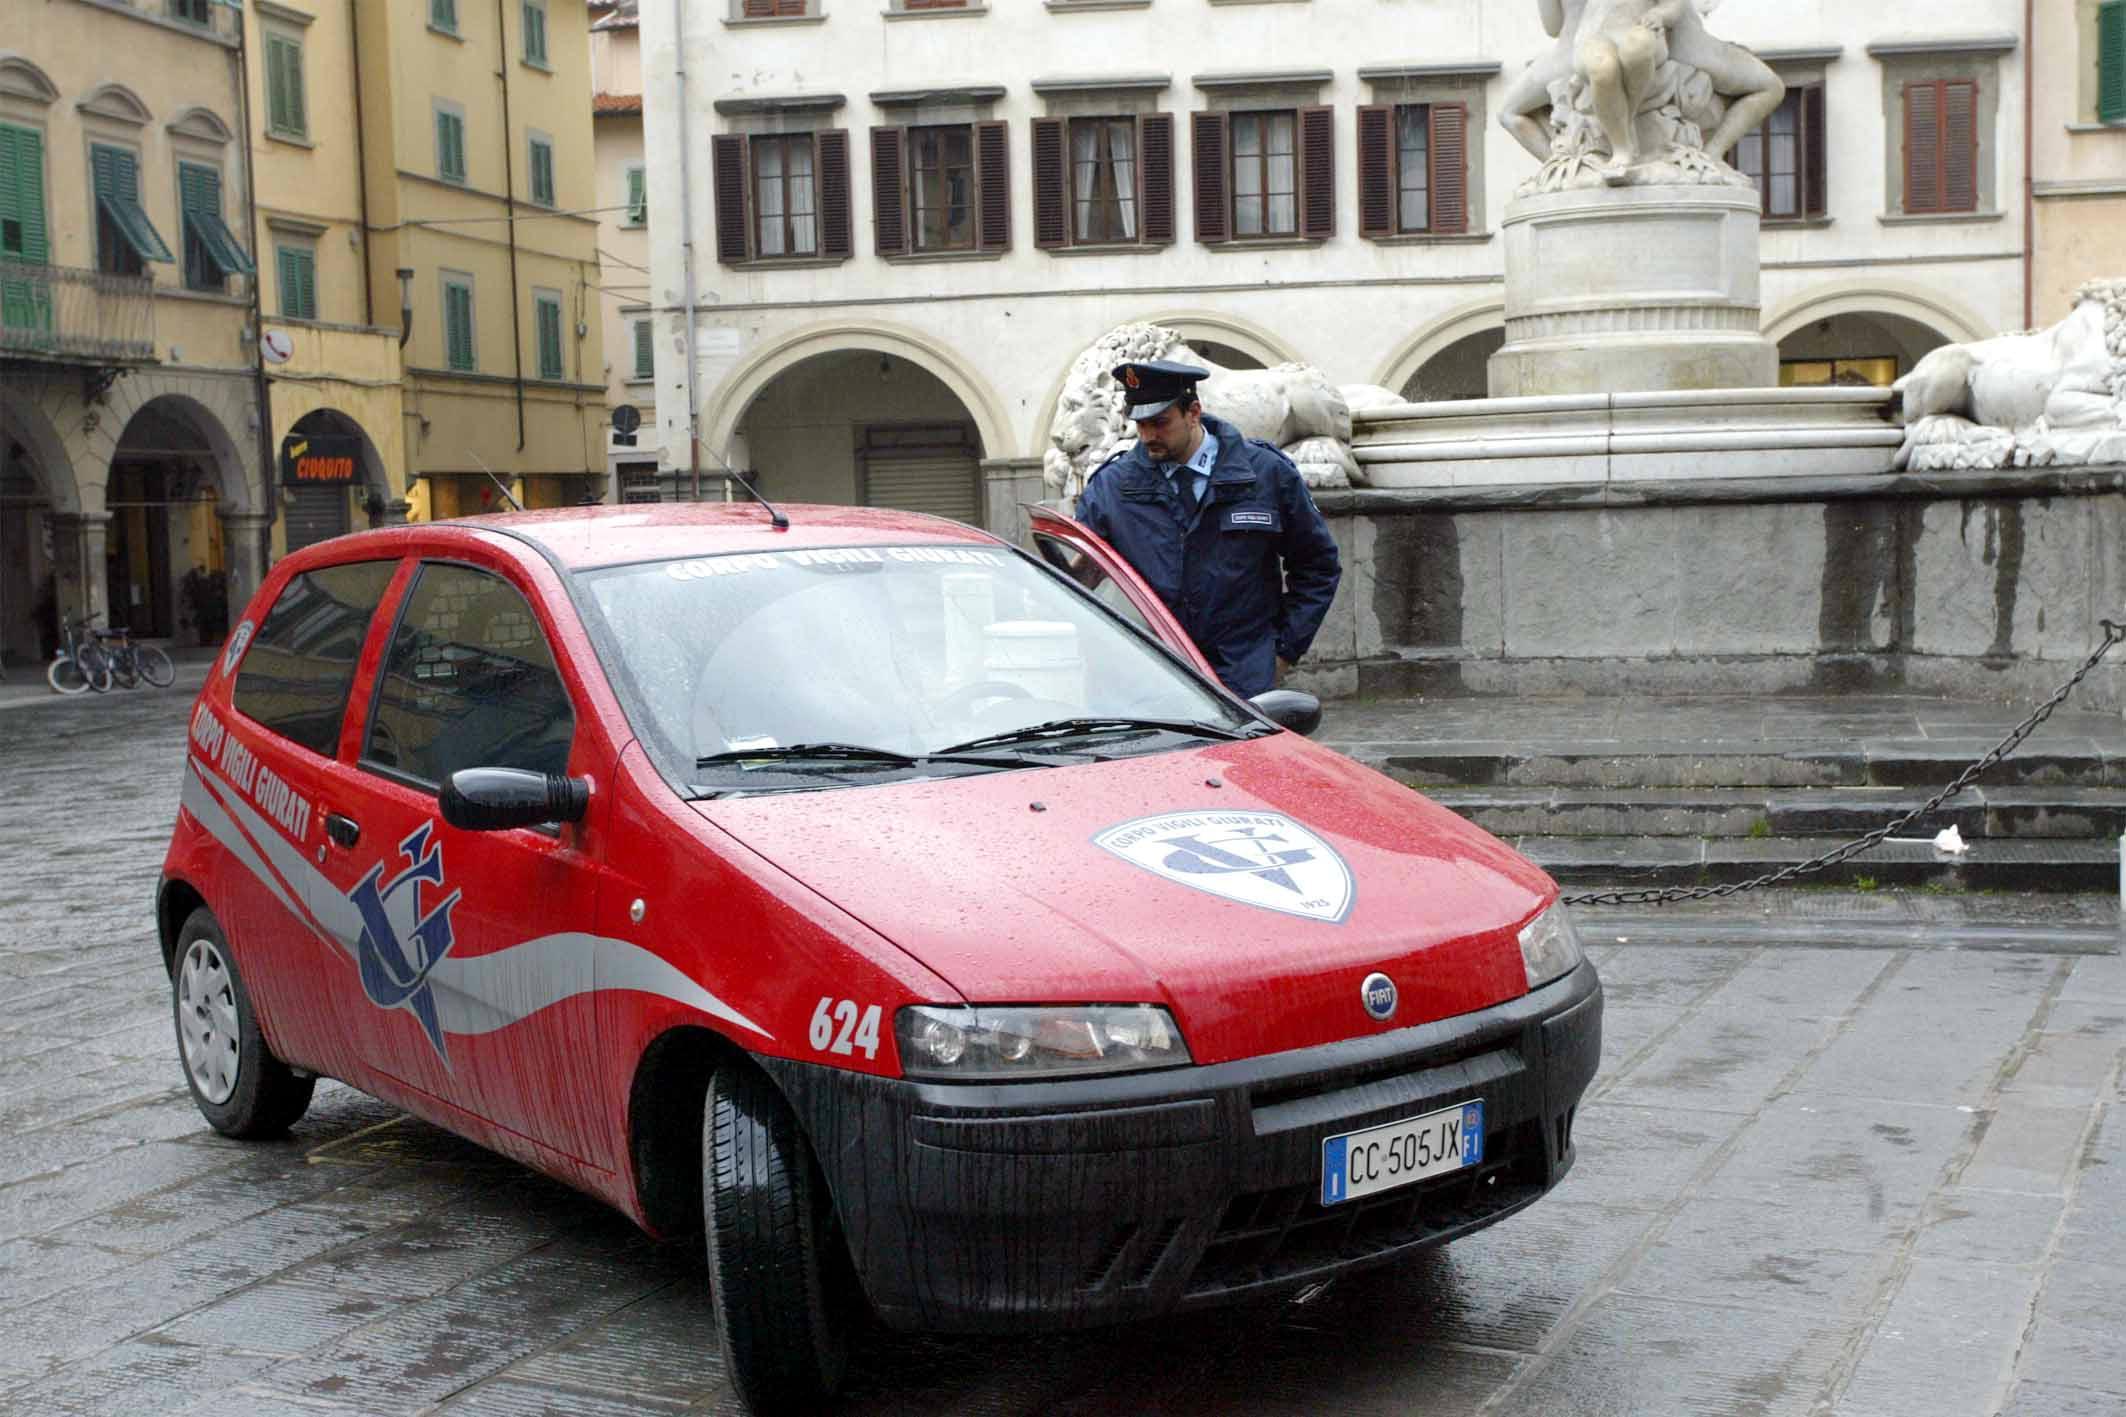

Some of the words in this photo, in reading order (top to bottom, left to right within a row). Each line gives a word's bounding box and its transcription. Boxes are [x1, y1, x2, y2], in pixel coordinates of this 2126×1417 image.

[666, 552, 780, 582] CORPO
[788, 547, 885, 566] VIGILI
[887, 547, 1005, 567] GIURATI
[220, 731, 258, 795] VIGILI
[255, 765, 311, 842] GIURATI
[1111, 826, 1156, 849] CORPO
[1368, 987, 1392, 1006] FIAT
[809, 996, 883, 1061] 624
[1331, 1172, 1339, 1197] I
[1462, 1132, 1479, 1158] FI
